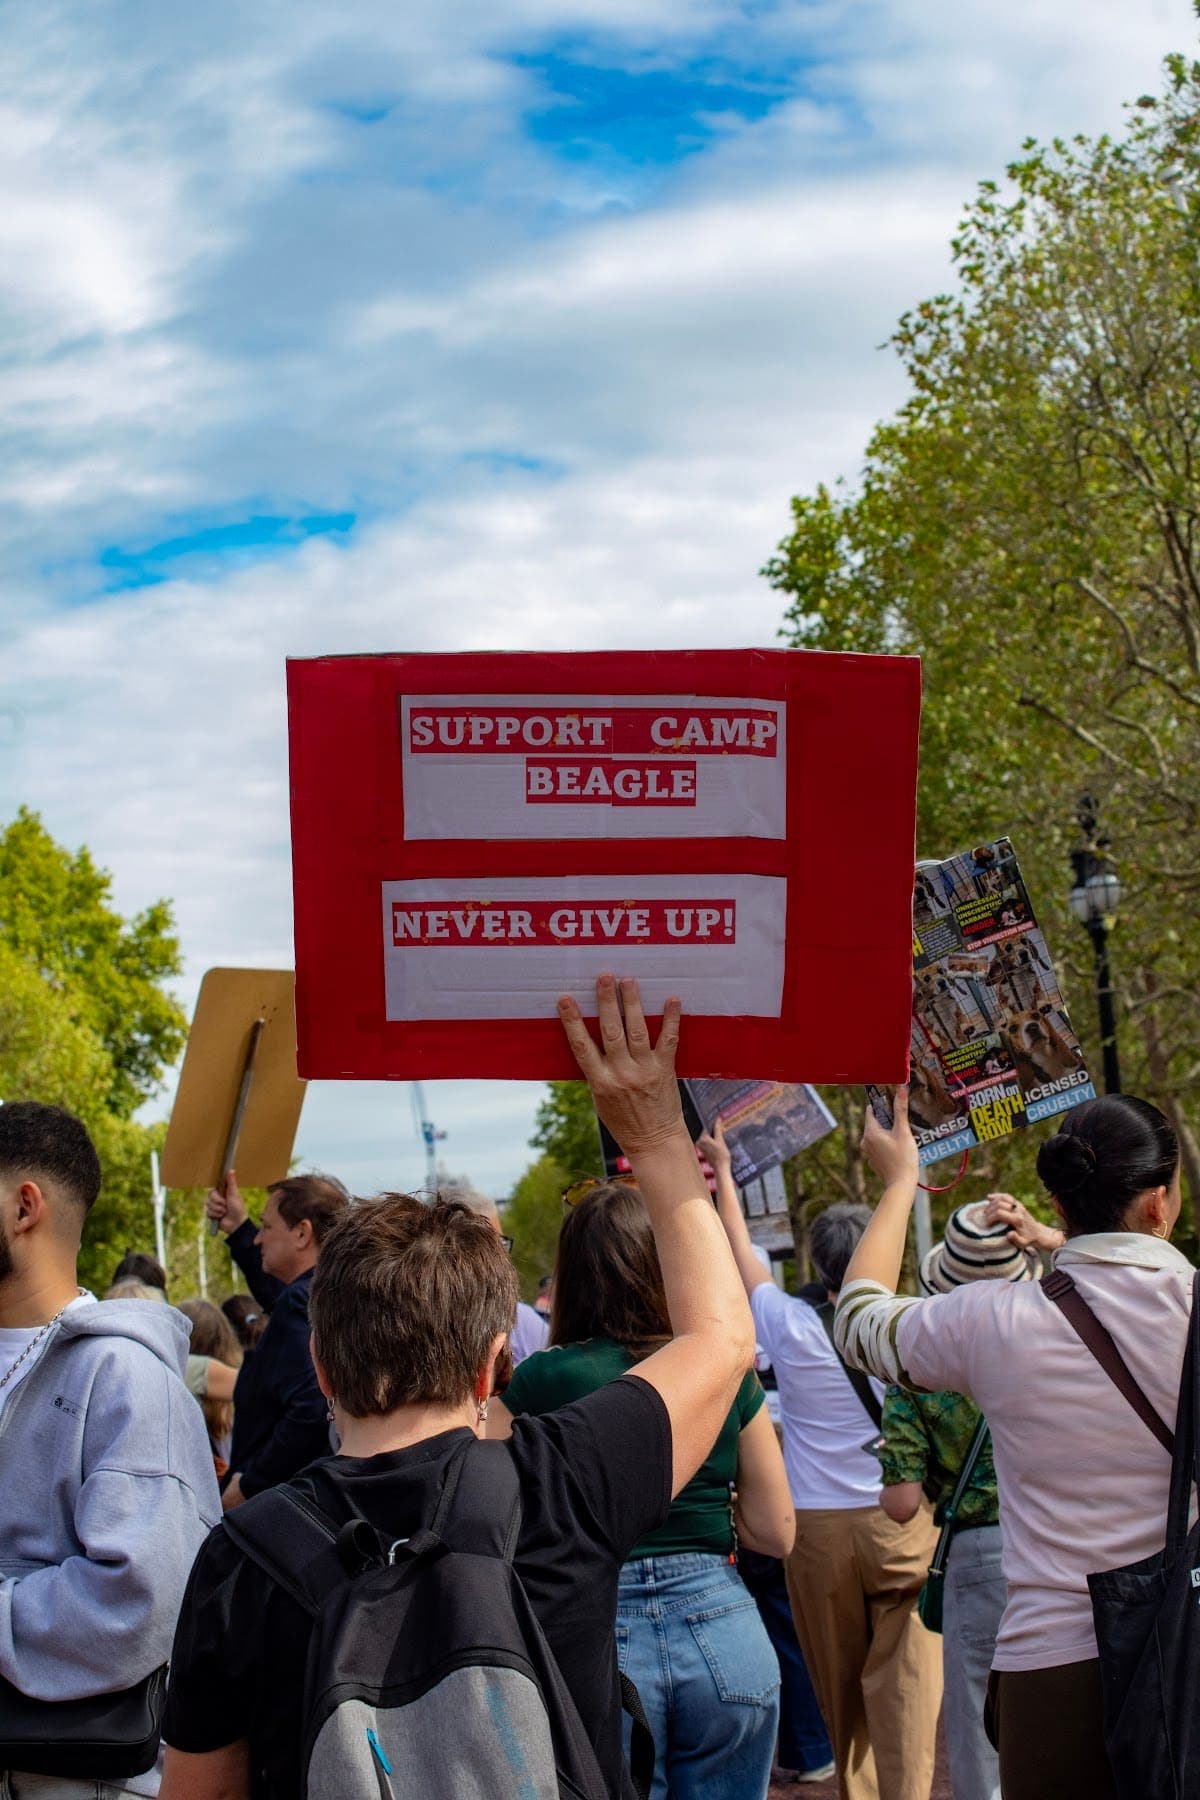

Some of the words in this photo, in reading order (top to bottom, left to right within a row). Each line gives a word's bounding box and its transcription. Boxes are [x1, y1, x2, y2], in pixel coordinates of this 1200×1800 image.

[411, 715, 612, 747] SUPPORT
[650, 716, 777, 749] CAMP
[527, 766, 696, 800] BEAGLE
[393, 910, 537, 939] NEVER
[548, 909, 651, 939] GIVE
[664, 908, 735, 938] UP!
[969, 1084, 1005, 1109] BORN
[1005, 1085, 1019, 1097] on
[1024, 1070, 1089, 1105] ICENSED
[1026, 1086, 1091, 1120] CRUELTY
[970, 1094, 1025, 1127] DEATH
[976, 1115, 1014, 1144] ROW
[919, 1132, 970, 1164] RUELTY
